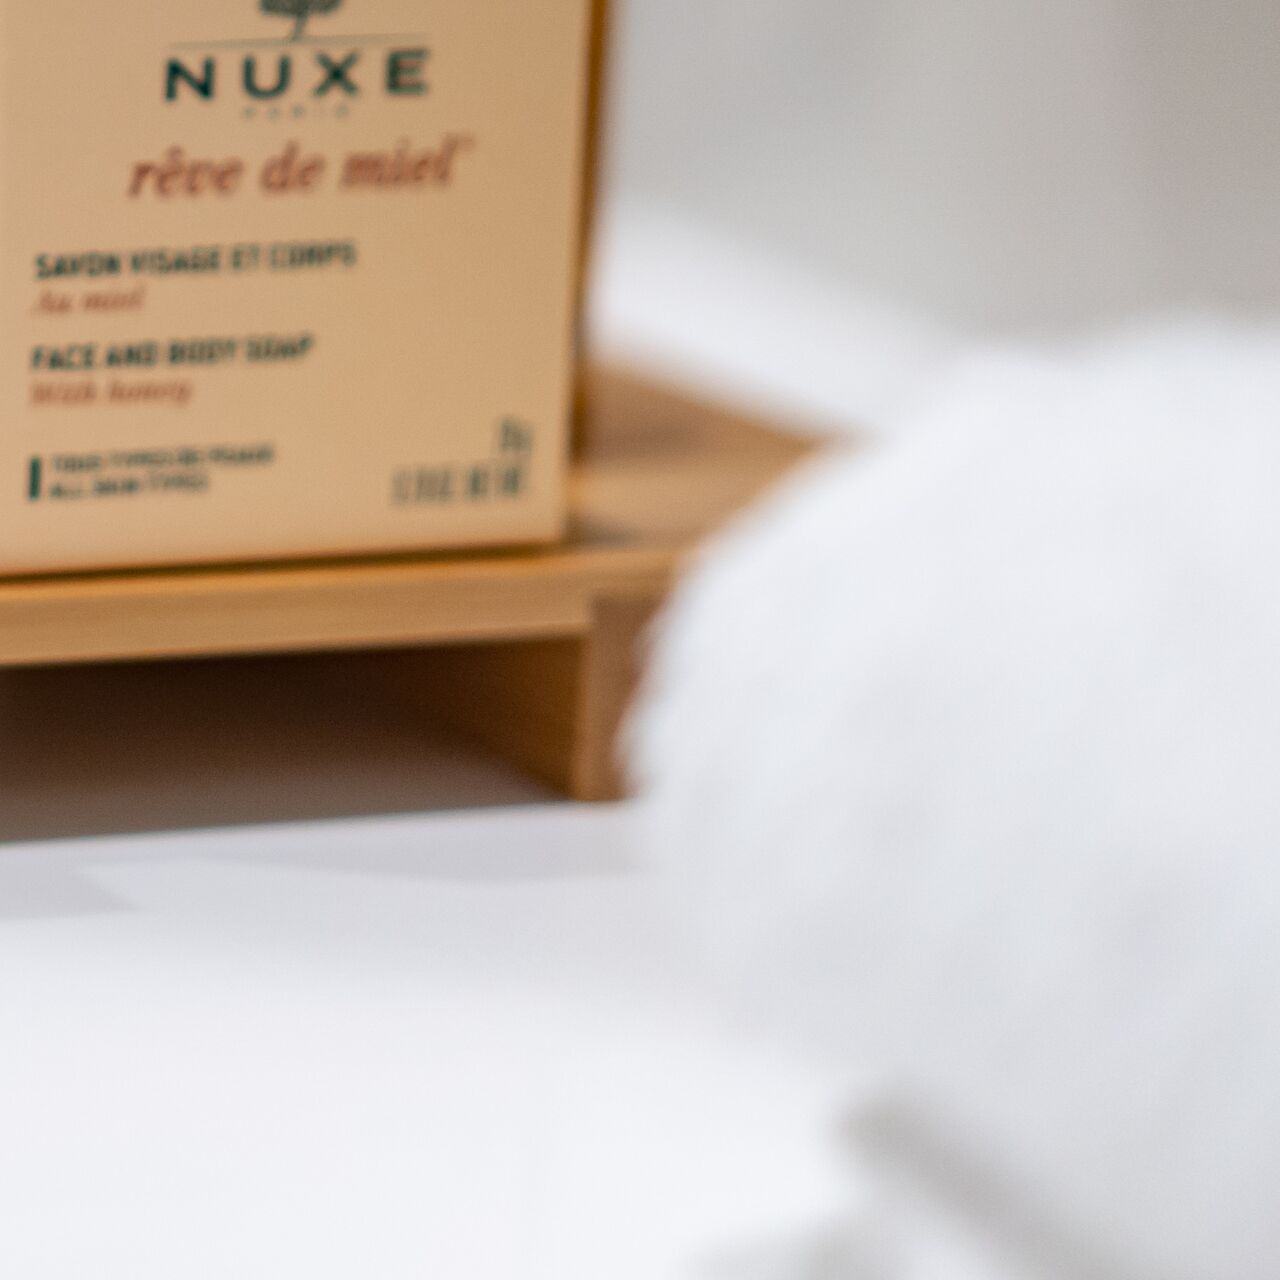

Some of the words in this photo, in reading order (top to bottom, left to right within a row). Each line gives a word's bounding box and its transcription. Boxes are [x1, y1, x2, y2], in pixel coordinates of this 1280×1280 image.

[164, 48, 429, 102] NUXE
[129, 145, 244, 198] rêve
[259, 138, 327, 196] de
[35, 253, 121, 281] SAVON
[130, 248, 221, 277] VISAGE
[31, 342, 94, 370] FACE
